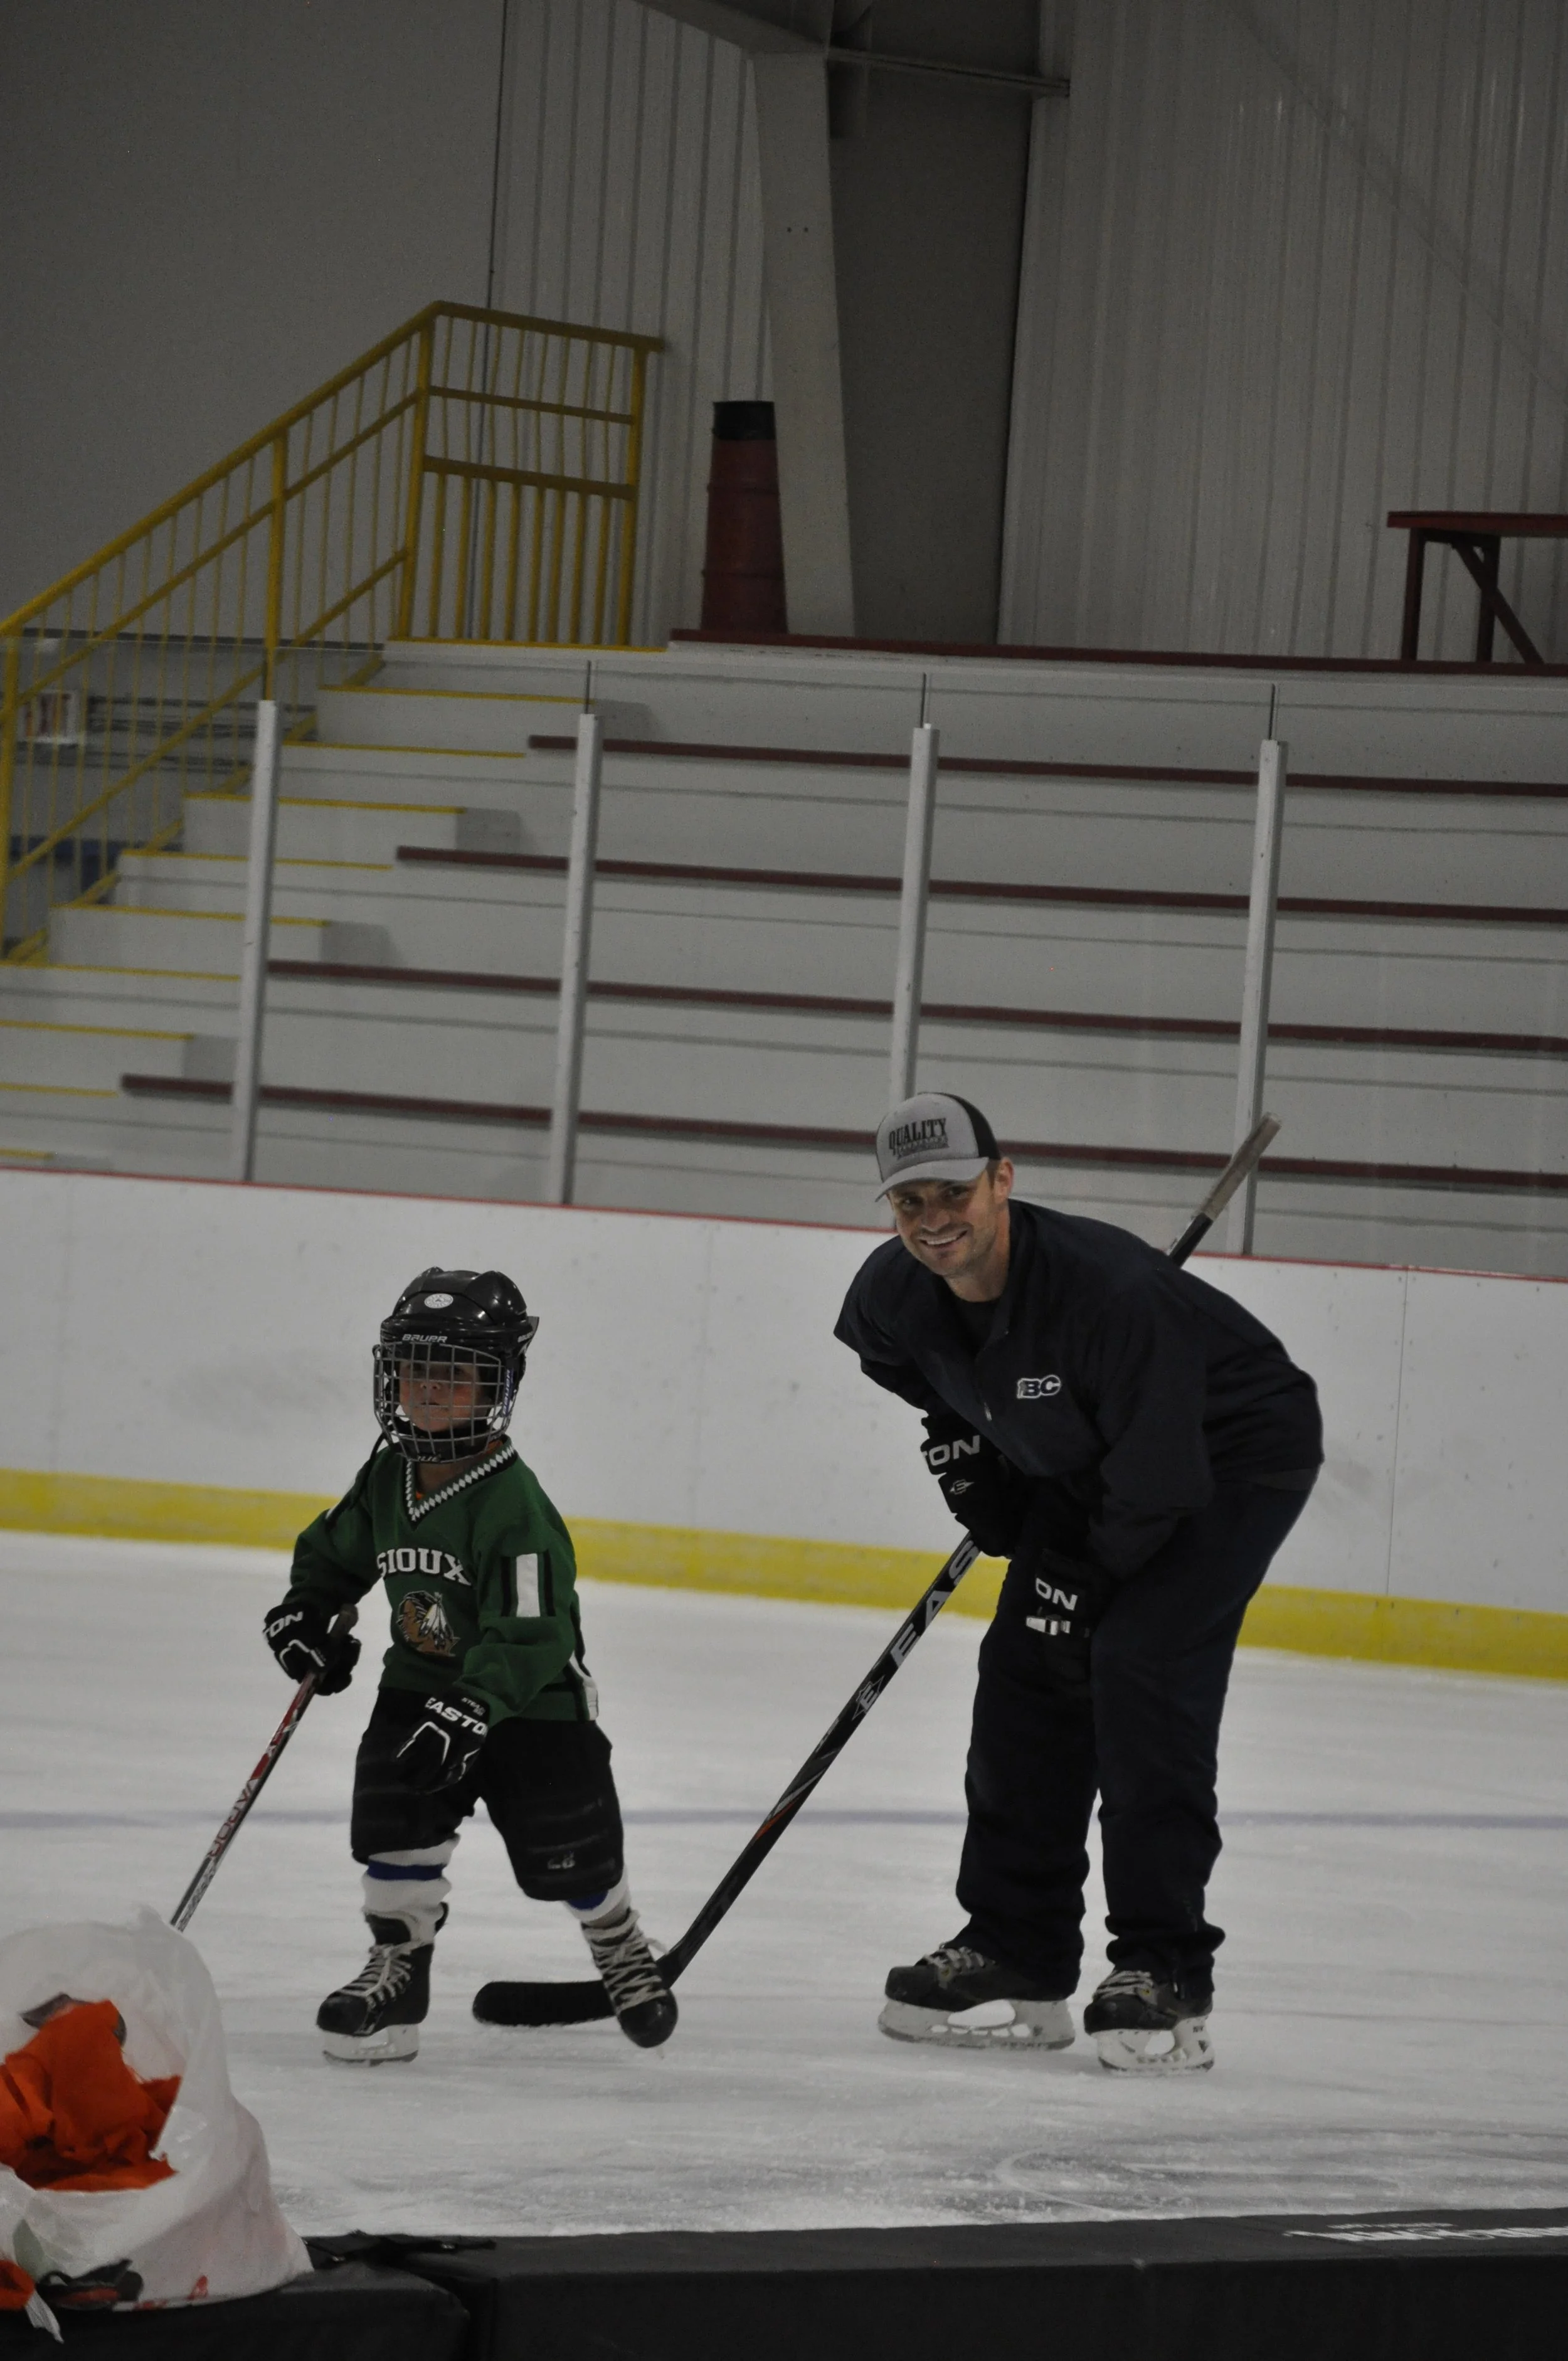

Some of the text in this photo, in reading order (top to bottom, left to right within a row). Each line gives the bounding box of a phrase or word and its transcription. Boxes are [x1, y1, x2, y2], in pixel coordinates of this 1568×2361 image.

[889, 1118, 946, 1155] QUALITY
[402, 1333, 448, 1344] BAUER
[1016, 1373, 1062, 1399] BC
[376, 1548, 472, 1586] SIOUX
[890, 1540, 980, 1668] EAS
